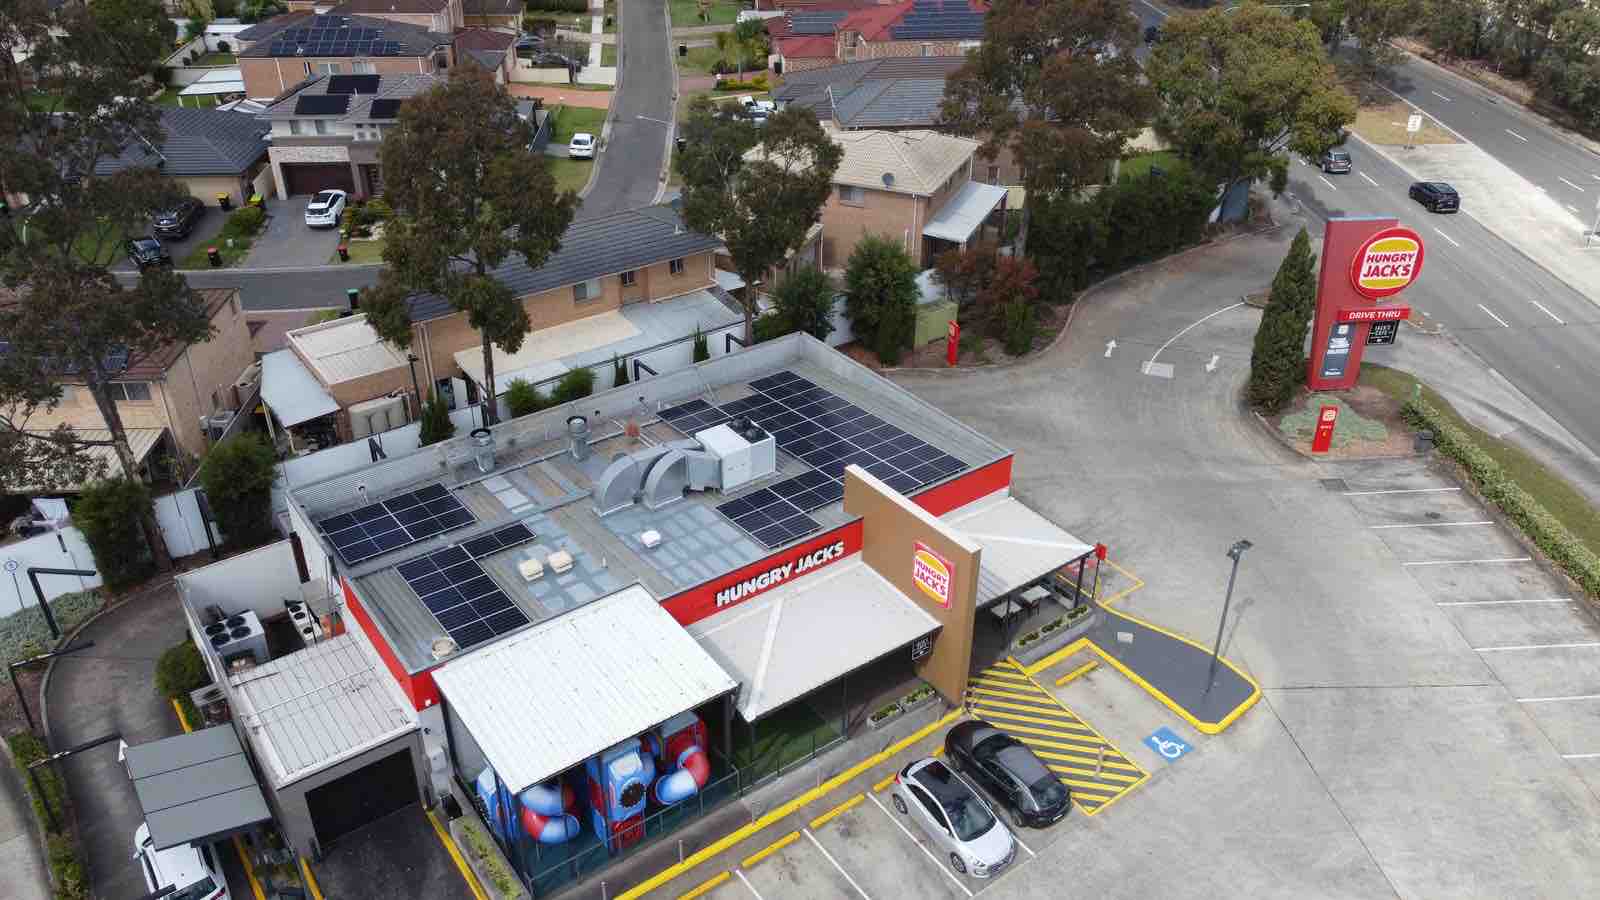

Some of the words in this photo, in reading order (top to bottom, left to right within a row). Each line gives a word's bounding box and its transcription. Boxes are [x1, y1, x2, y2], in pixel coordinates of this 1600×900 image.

[1366, 253, 1415, 263] HUNGRY
[1349, 311, 1375, 320] DRIVE
[1377, 310, 1401, 319] THRU
[915, 559, 946, 584] HUNGRY
[716, 563, 792, 607] HUNGRY
